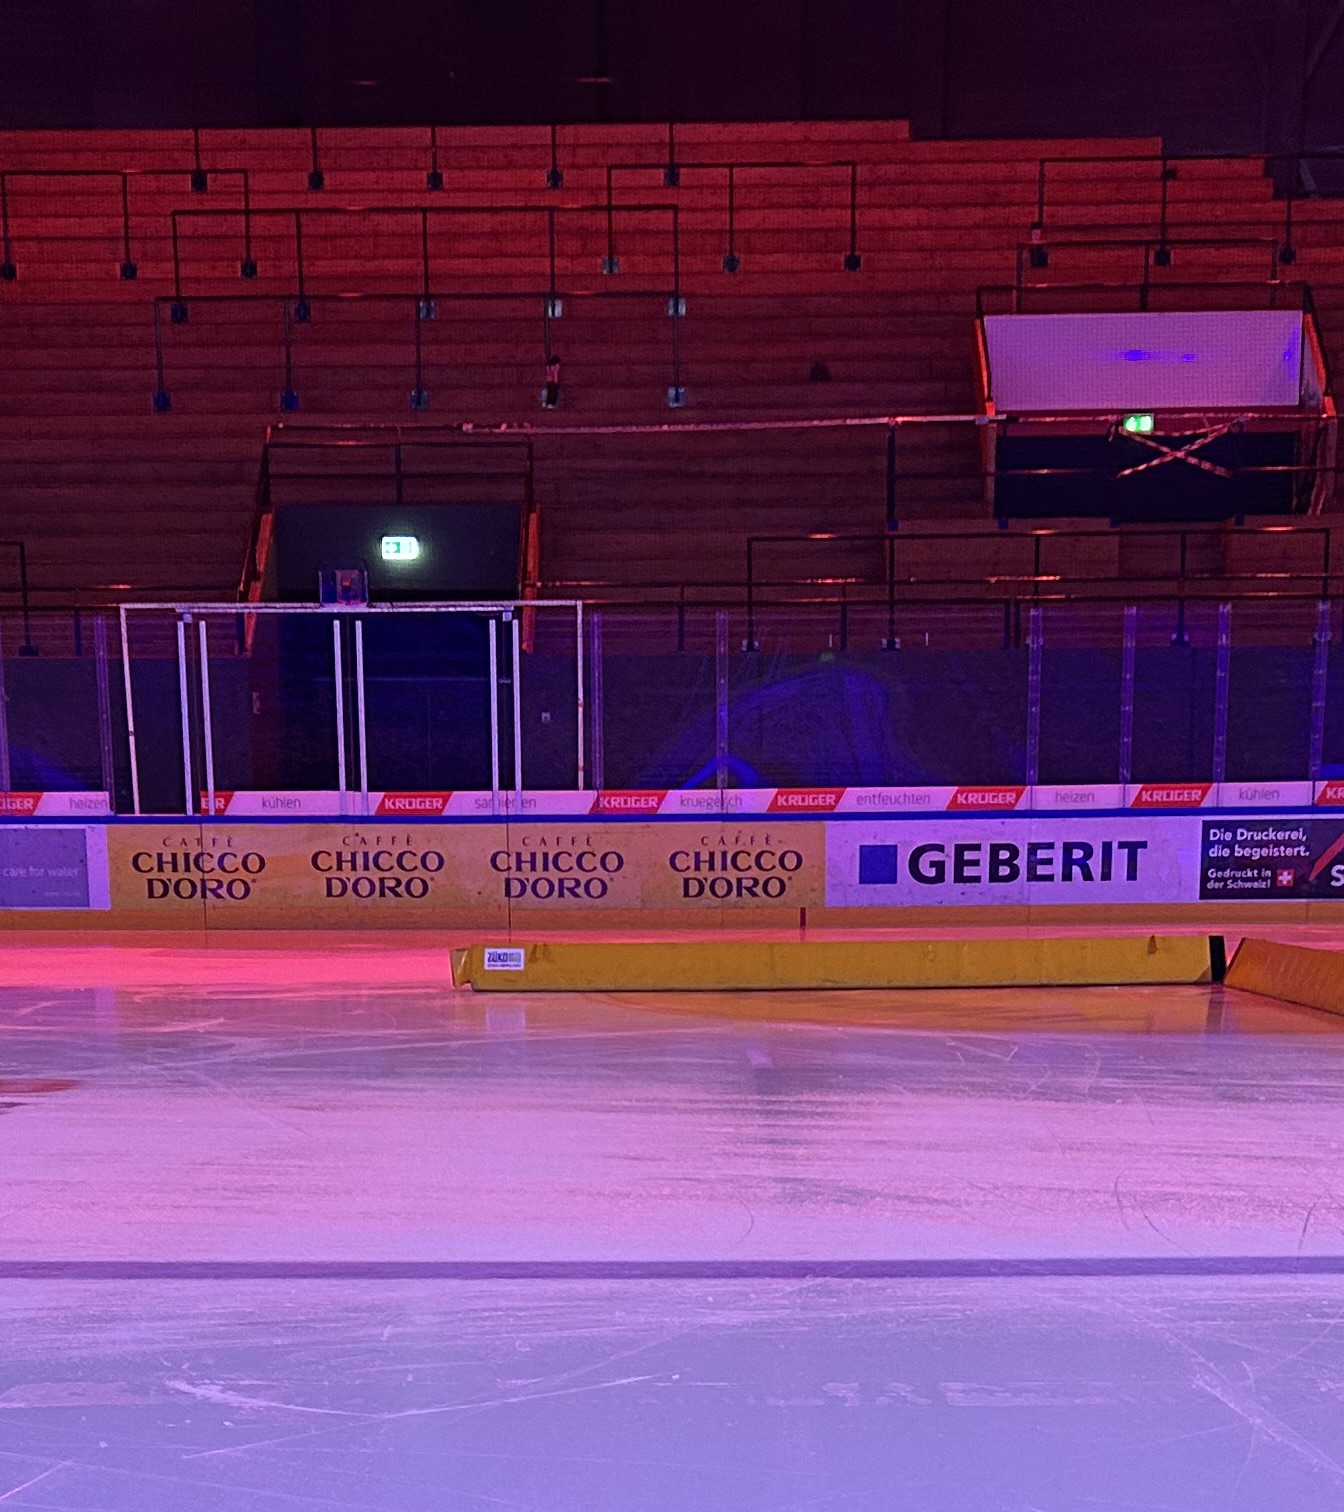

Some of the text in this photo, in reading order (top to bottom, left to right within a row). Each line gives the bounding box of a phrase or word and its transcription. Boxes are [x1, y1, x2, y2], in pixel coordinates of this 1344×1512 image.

[856, 791, 931, 806] entfeuchten
[1209, 828, 1233, 841] Die
[131, 851, 266, 874] CHICCO
[310, 850, 445, 873] CHICCO
[490, 851, 625, 873] CHICCO
[669, 850, 803, 872] CHICCO
[908, 840, 1148, 885] GEBERIT
[1208, 843, 1310, 860] die begeistert.
[3, 866, 27, 878] care
[29, 865, 46, 878] for
[48, 866, 80, 878] water
[1207, 867, 1272, 879] Gedruckt in
[146, 878, 251, 900] D'ORO
[325, 877, 429, 899] D'ORO
[504, 877, 608, 899] D'ORO
[682, 876, 787, 899] D'ORO
[1206, 879, 1224, 890] der
